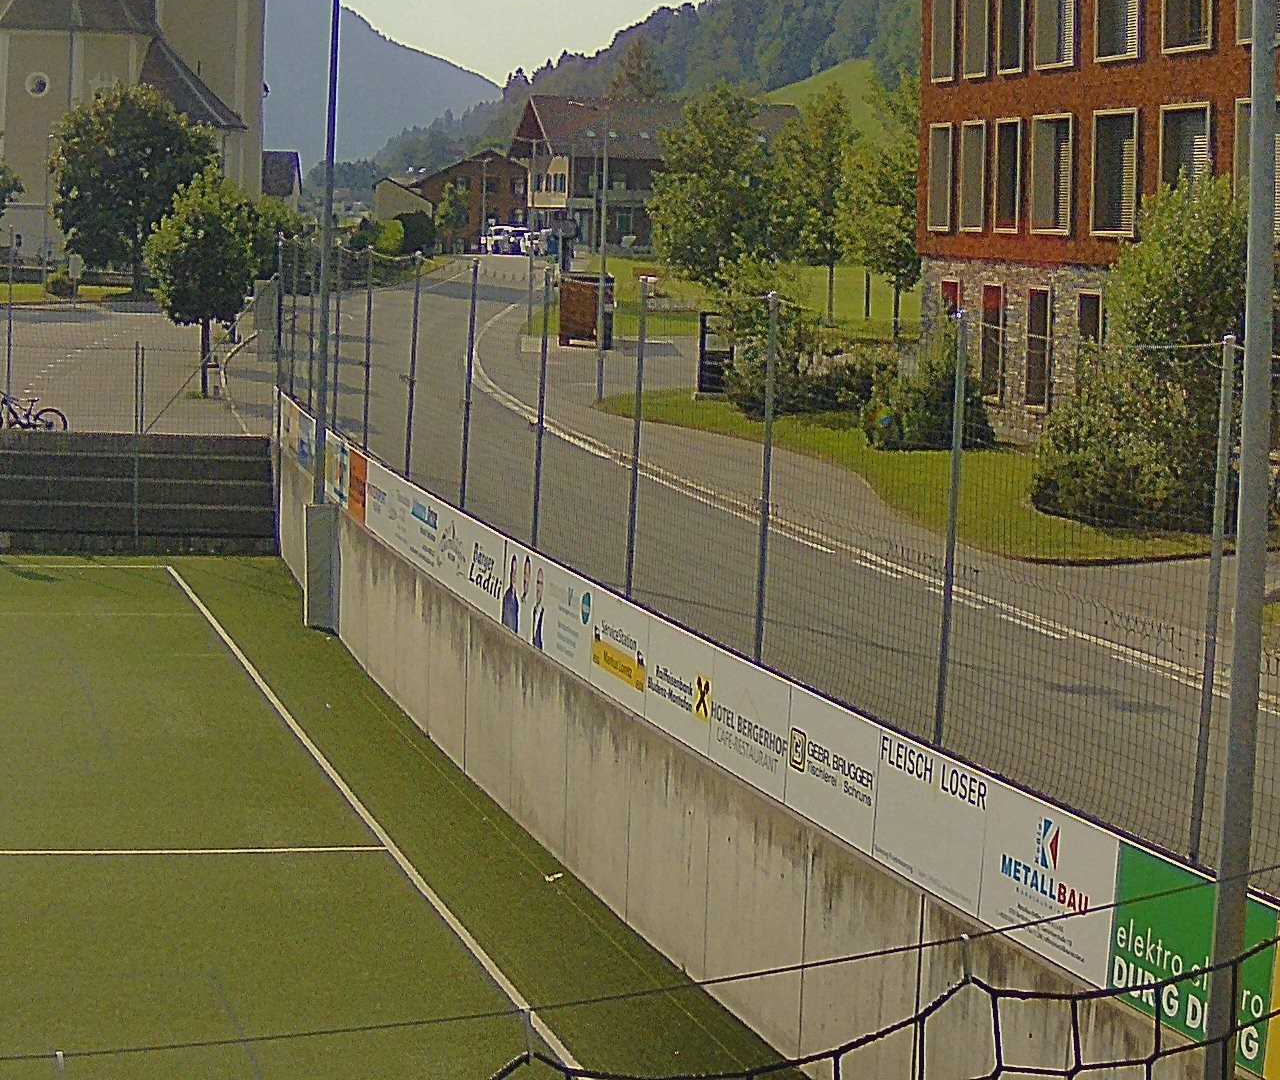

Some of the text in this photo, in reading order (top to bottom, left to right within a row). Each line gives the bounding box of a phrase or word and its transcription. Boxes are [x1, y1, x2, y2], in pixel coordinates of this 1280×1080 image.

[711, 701, 788, 758] HOTEL BERGERHOF
[807, 741, 873, 791] GEBR. BRUGGER
[843, 780, 872, 807] Schruns
[880, 735, 987, 811] FLEISCH LOSER
[1001, 853, 1089, 916] METALLBAU
[1116, 918, 1183, 976] elektro
